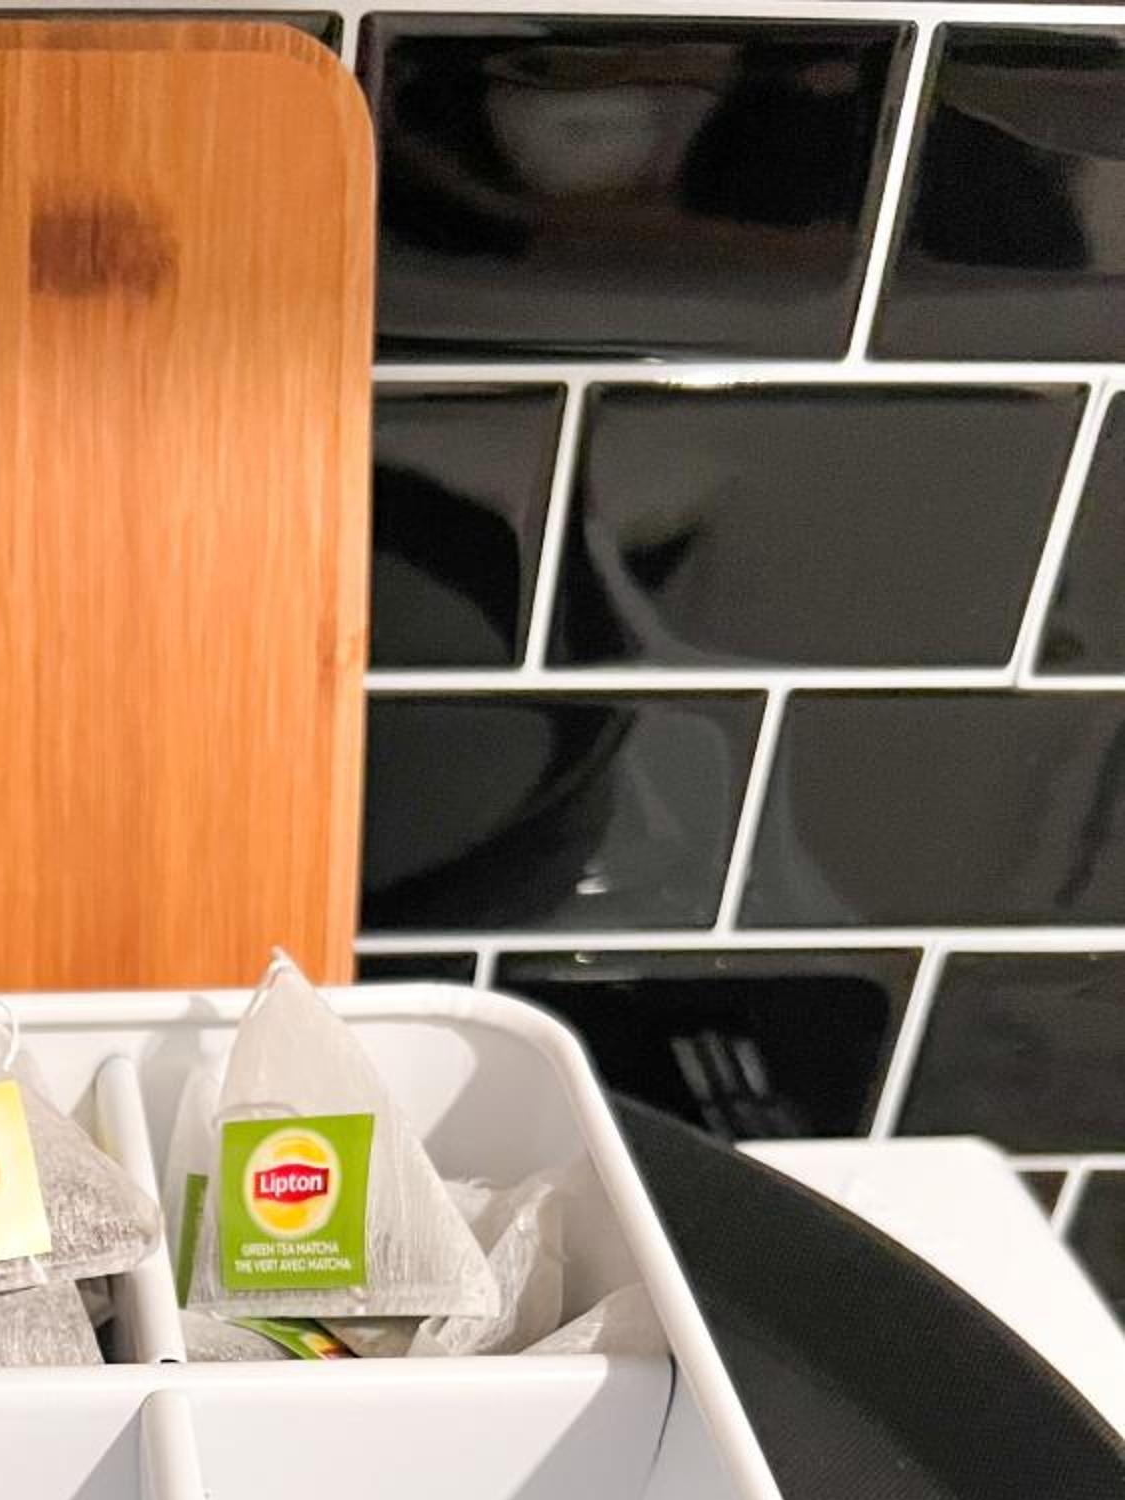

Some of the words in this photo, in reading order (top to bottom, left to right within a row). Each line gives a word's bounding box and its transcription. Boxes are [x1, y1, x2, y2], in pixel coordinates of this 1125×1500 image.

[259, 1173, 323, 1197] Lipton
[241, 1243, 274, 1256] GREEN
[276, 1242, 295, 1255] TEA
[297, 1240, 339, 1254] MATCHA
[254, 1259, 278, 1273] VERT
[279, 1258, 307, 1272] AVEC
[308, 1257, 351, 1270] MATCHA
